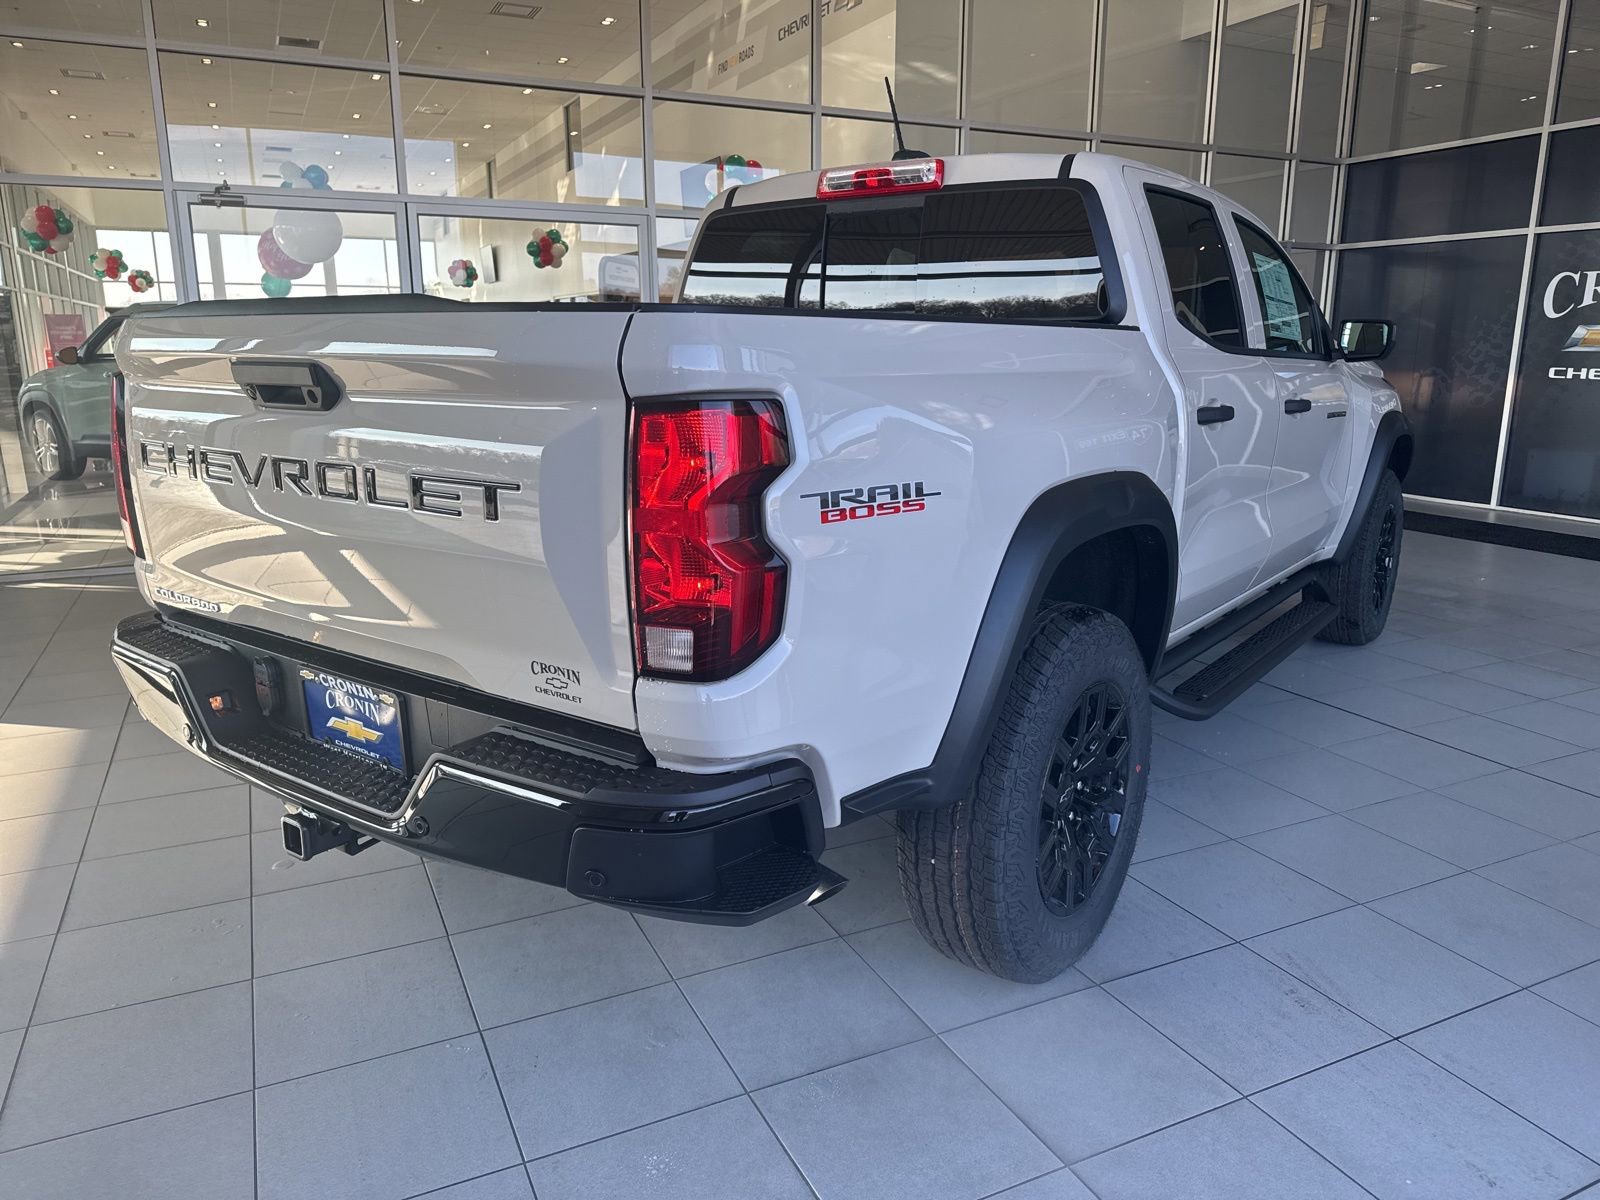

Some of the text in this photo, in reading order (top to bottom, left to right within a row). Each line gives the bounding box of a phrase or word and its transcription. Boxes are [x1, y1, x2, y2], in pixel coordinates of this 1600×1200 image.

[778, 1, 831, 41] CHEVRET
[717, 60, 728, 75] FIND
[738, 45, 754, 63] ROADS
[140, 438, 521, 522] CHEVROLET
[800, 481, 941, 509] TRAIL
[820, 498, 926, 524] BOSS
[155, 586, 220, 612] COLORADO
[319, 673, 377, 700] CRONIN
[531, 660, 581, 686] CRONIN
[326, 690, 380, 726] CRONIN
[535, 686, 582, 703] CHEVROLET
[335, 740, 380, 759] CHEVROLET
